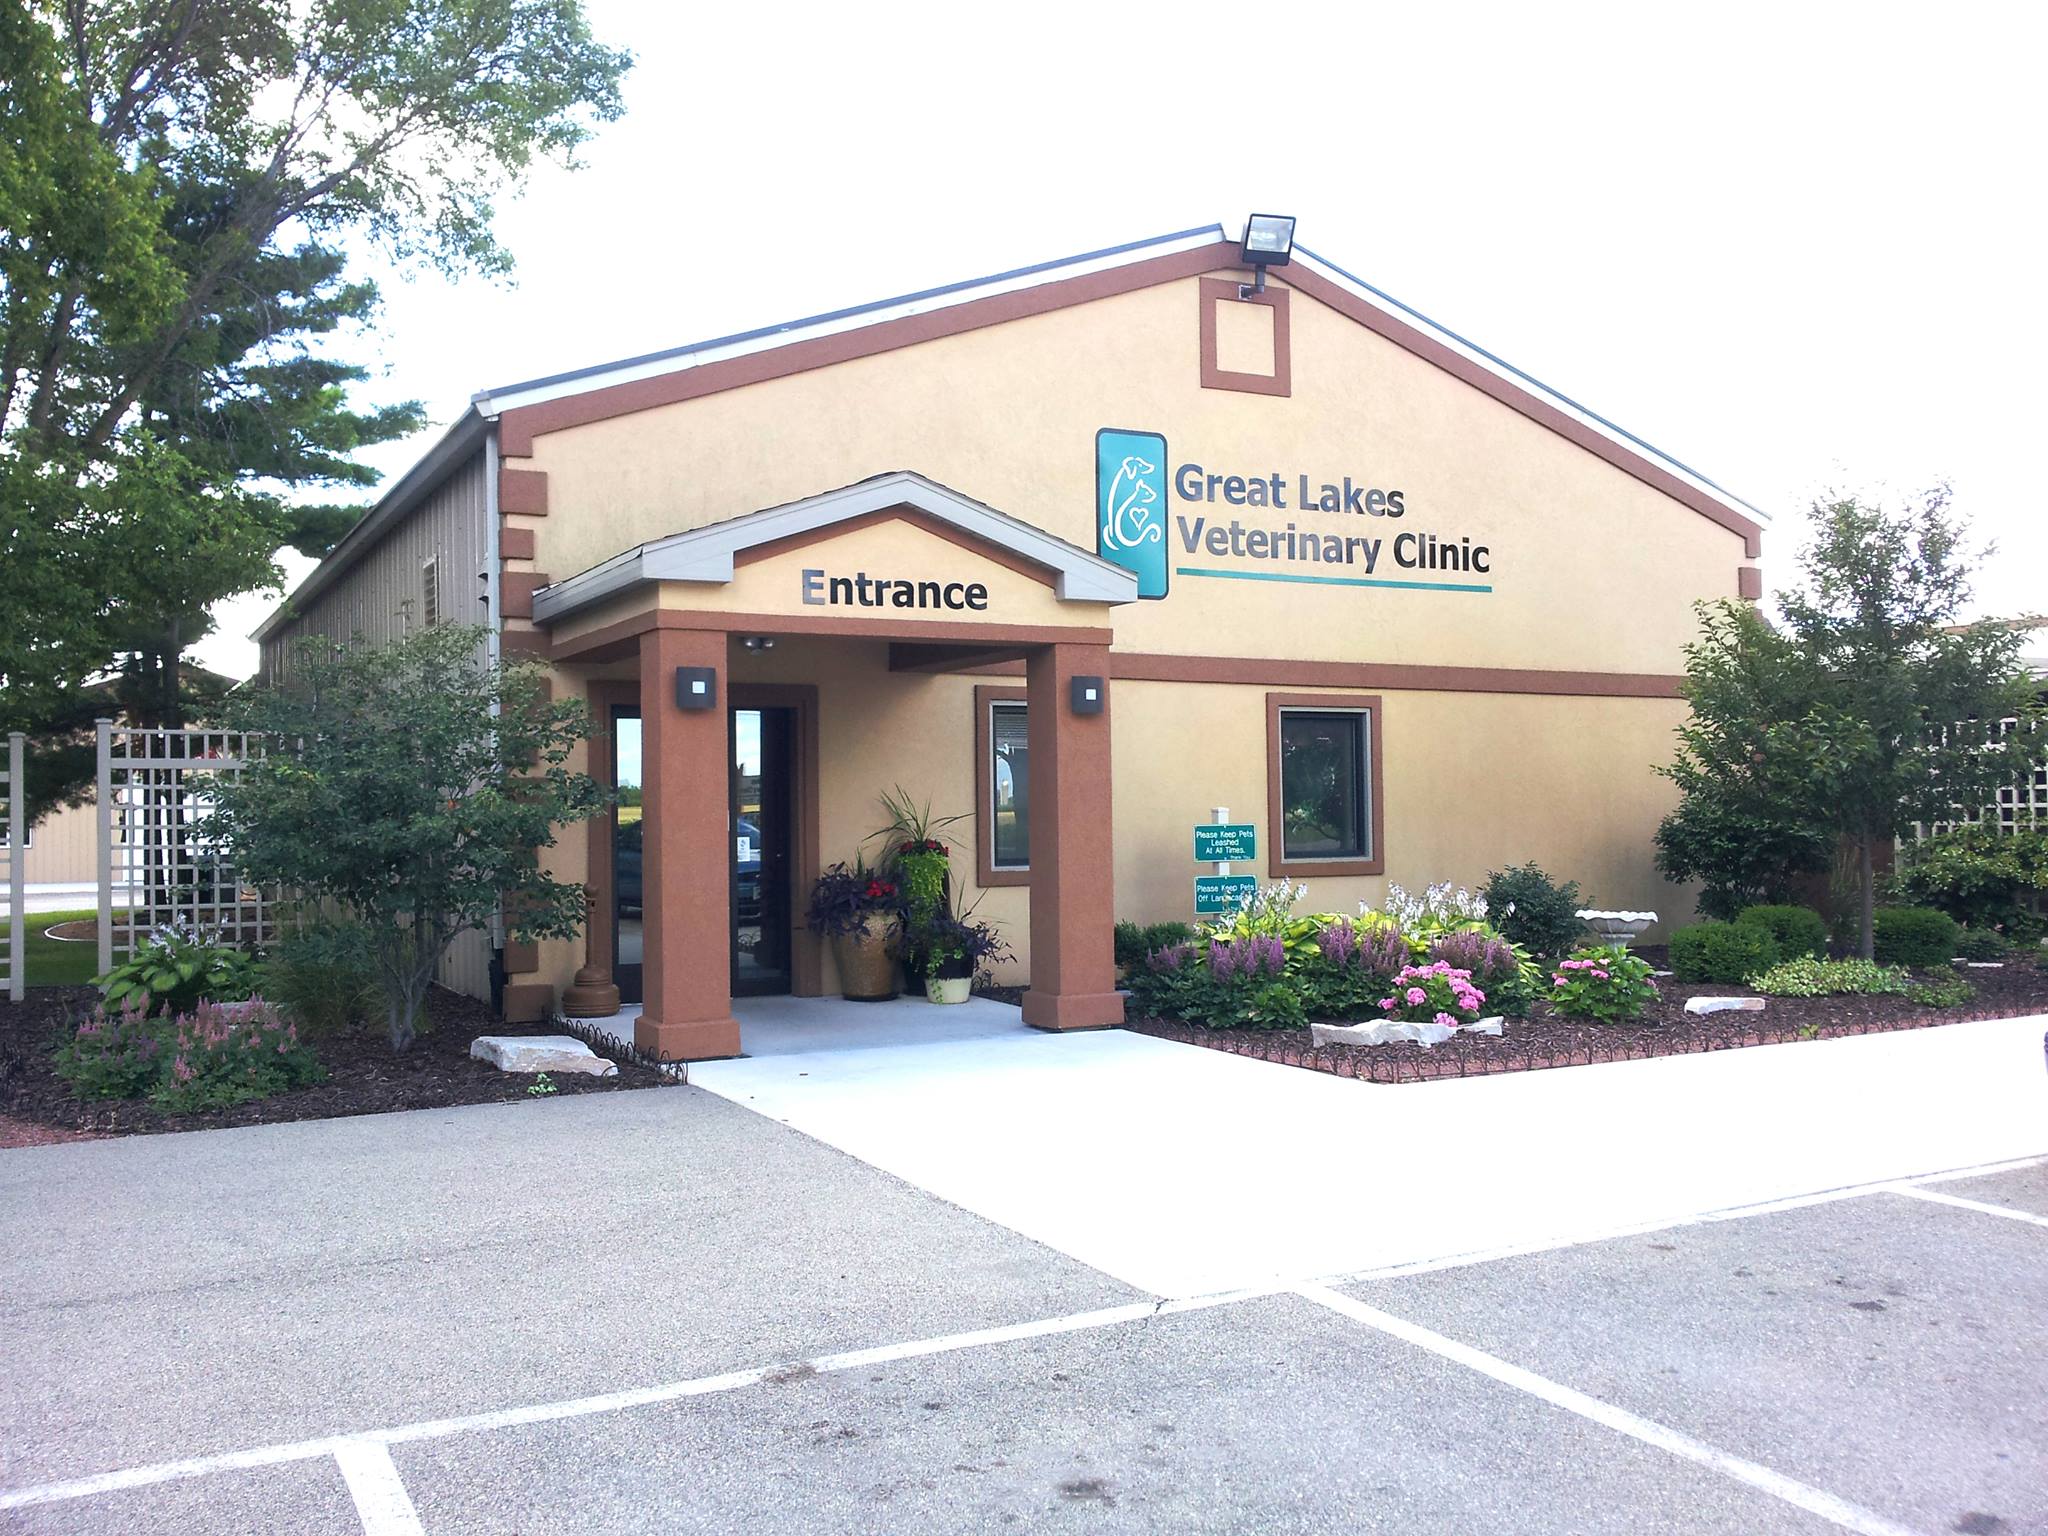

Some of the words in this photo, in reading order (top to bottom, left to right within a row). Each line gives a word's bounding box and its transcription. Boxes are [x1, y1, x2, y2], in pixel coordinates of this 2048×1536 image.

[1175, 463, 1287, 509] Great
[1299, 474, 1405, 518] Lakes
[1176, 515, 1382, 574] Veterinary
[1393, 532, 1490, 573] Clinic
[801, 569, 988, 611] Entrance
[1196, 831, 1218, 839] Please
[1239, 830, 1253, 838] Pets
[1215, 846, 1223, 854] All
[1197, 884, 1219, 893] Please
[1221, 884, 1238, 892] Keep
[1240, 883, 1255, 891] Pets
[1197, 894, 1208, 902] Off
